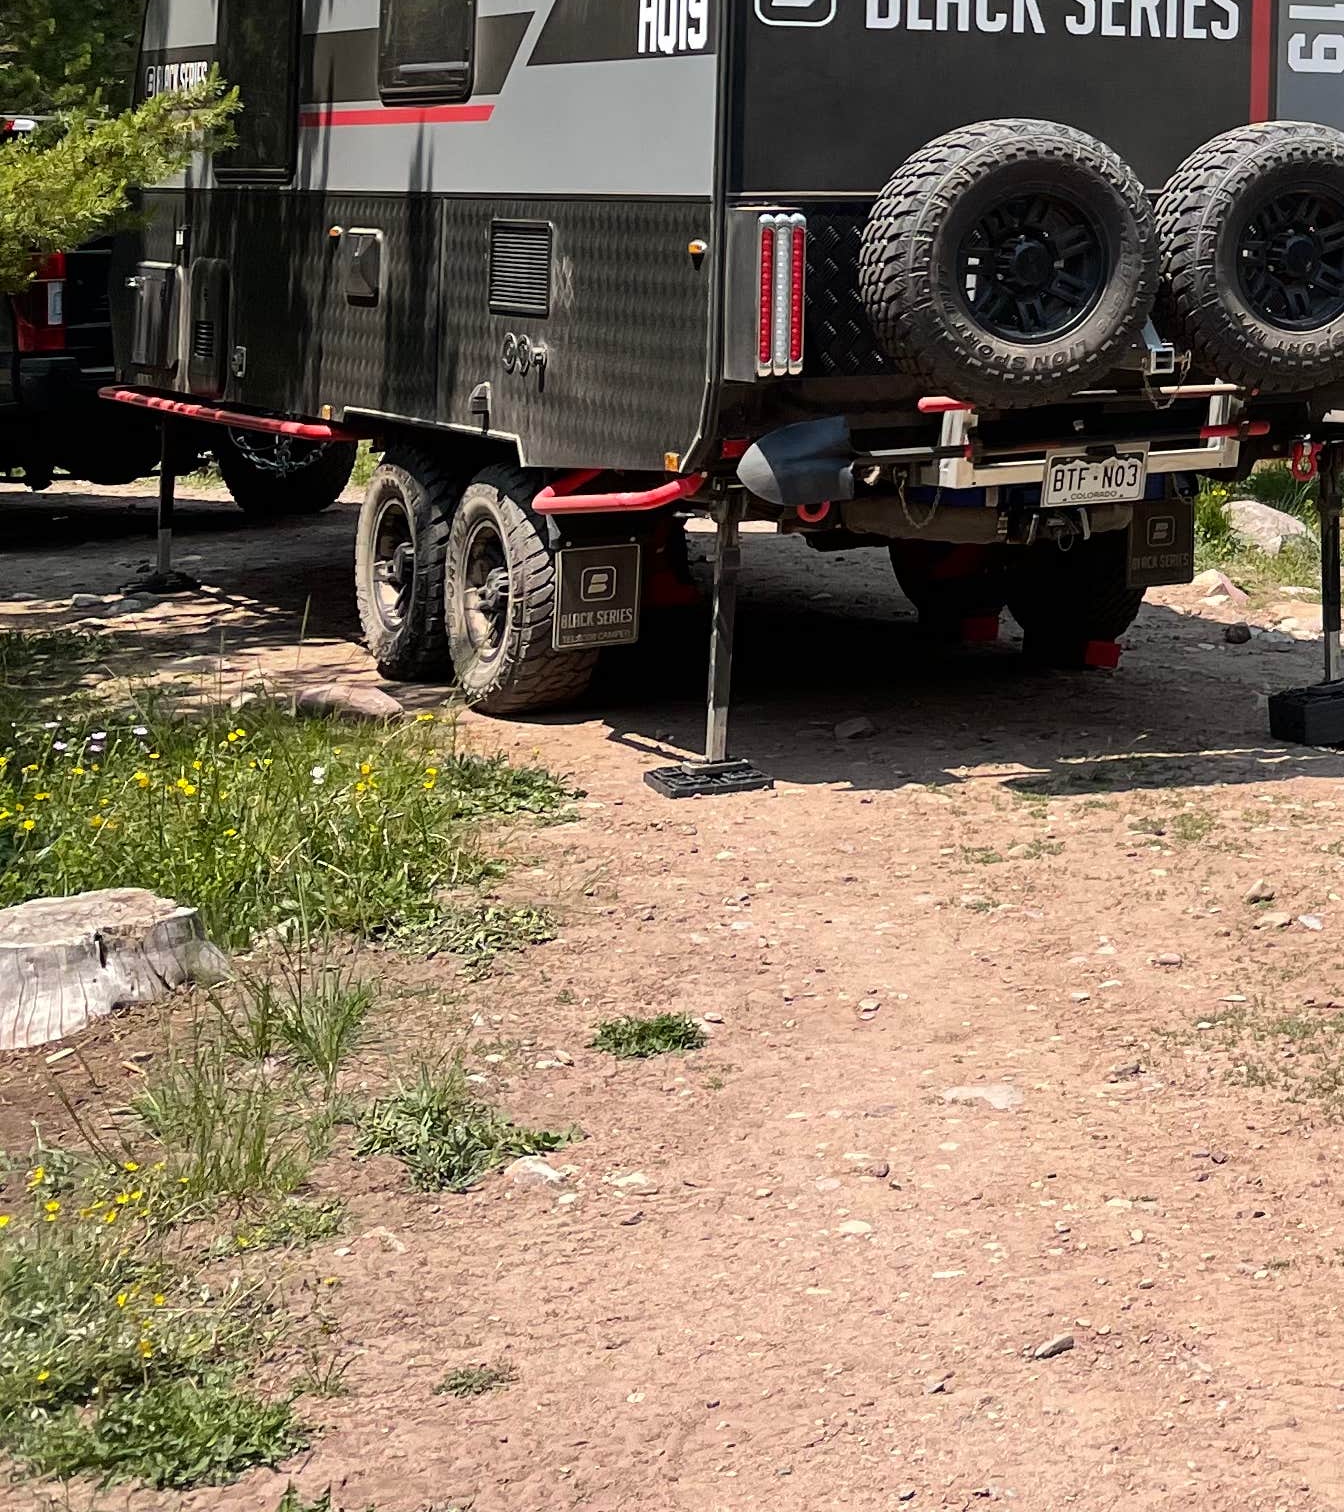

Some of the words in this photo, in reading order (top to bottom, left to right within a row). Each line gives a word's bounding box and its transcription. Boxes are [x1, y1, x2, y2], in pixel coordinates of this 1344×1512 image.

[1070, 490, 1118, 500] COLORADO
[561, 611, 595, 629] BLACK
[597, 608, 633, 625] SERIES
